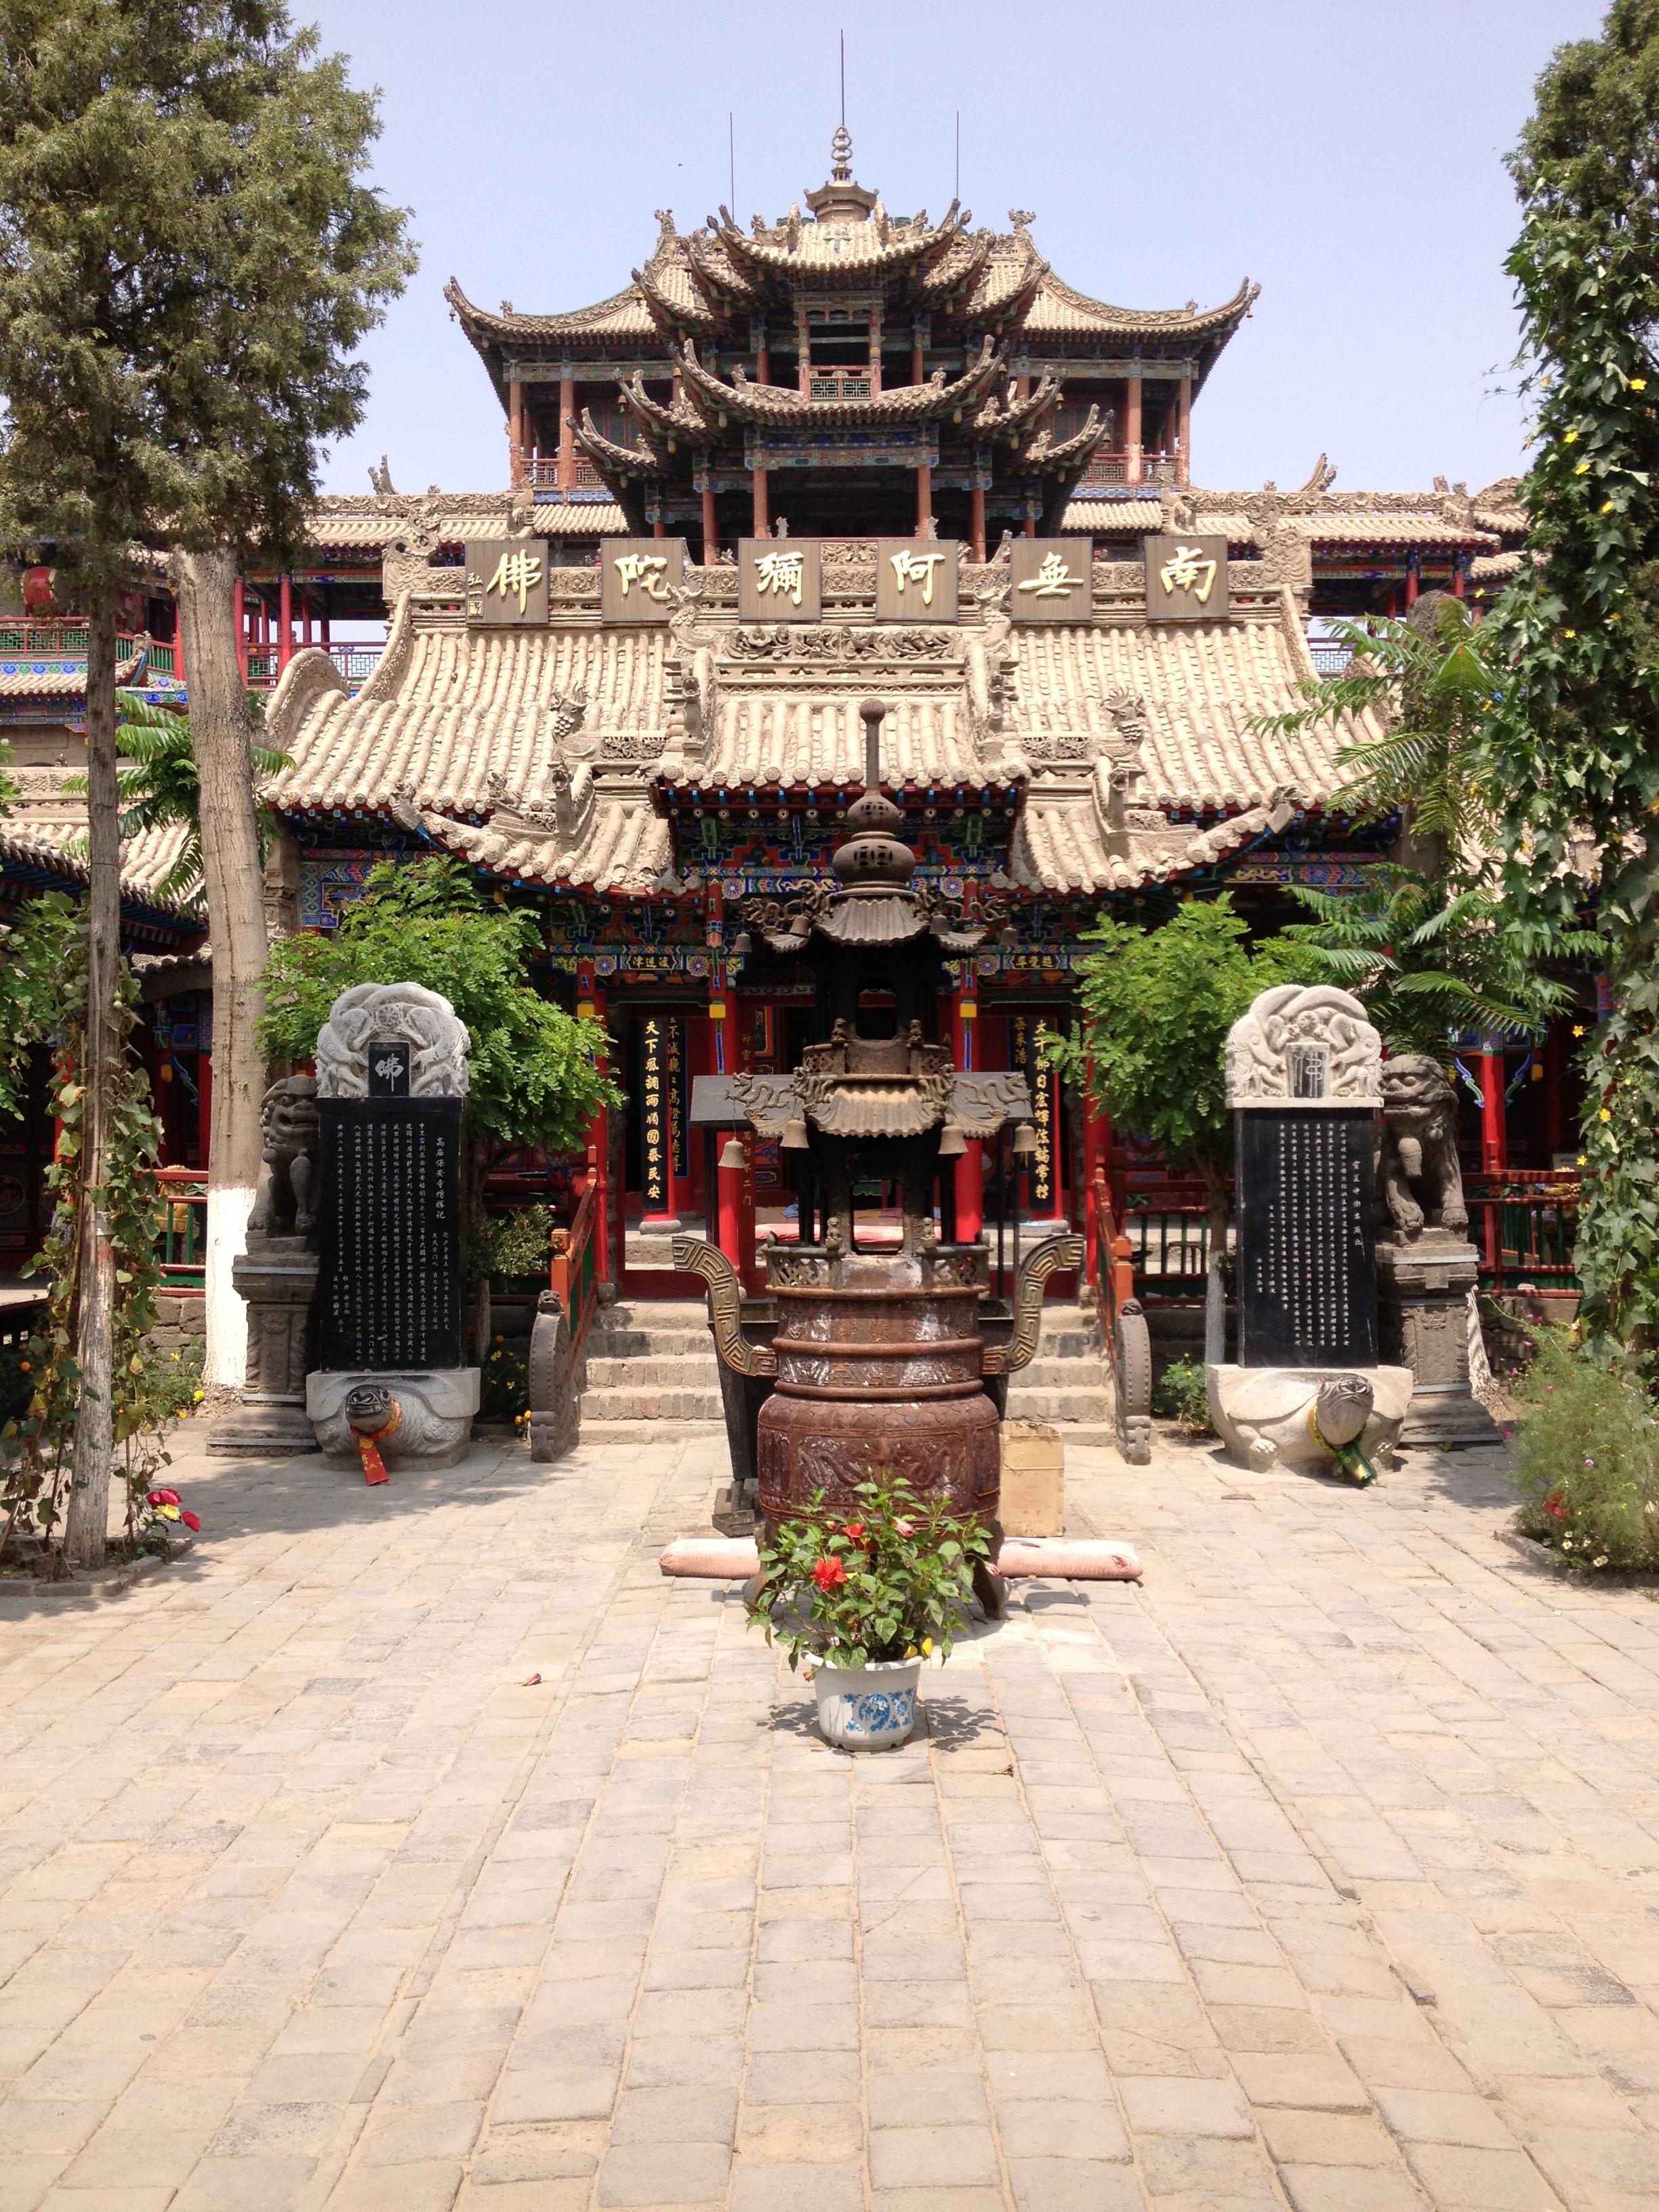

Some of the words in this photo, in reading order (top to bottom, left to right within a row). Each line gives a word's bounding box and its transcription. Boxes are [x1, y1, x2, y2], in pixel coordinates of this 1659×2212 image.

[468, 572, 483, 596] 弘一
[486, 548, 543, 614] 佛
[613, 552, 672, 601] 陀
[754, 550, 805, 607] 彌
[889, 549, 945, 605] 阿
[1160, 546, 1217, 604] 南
[375, 1053, 405, 1092] 佛
